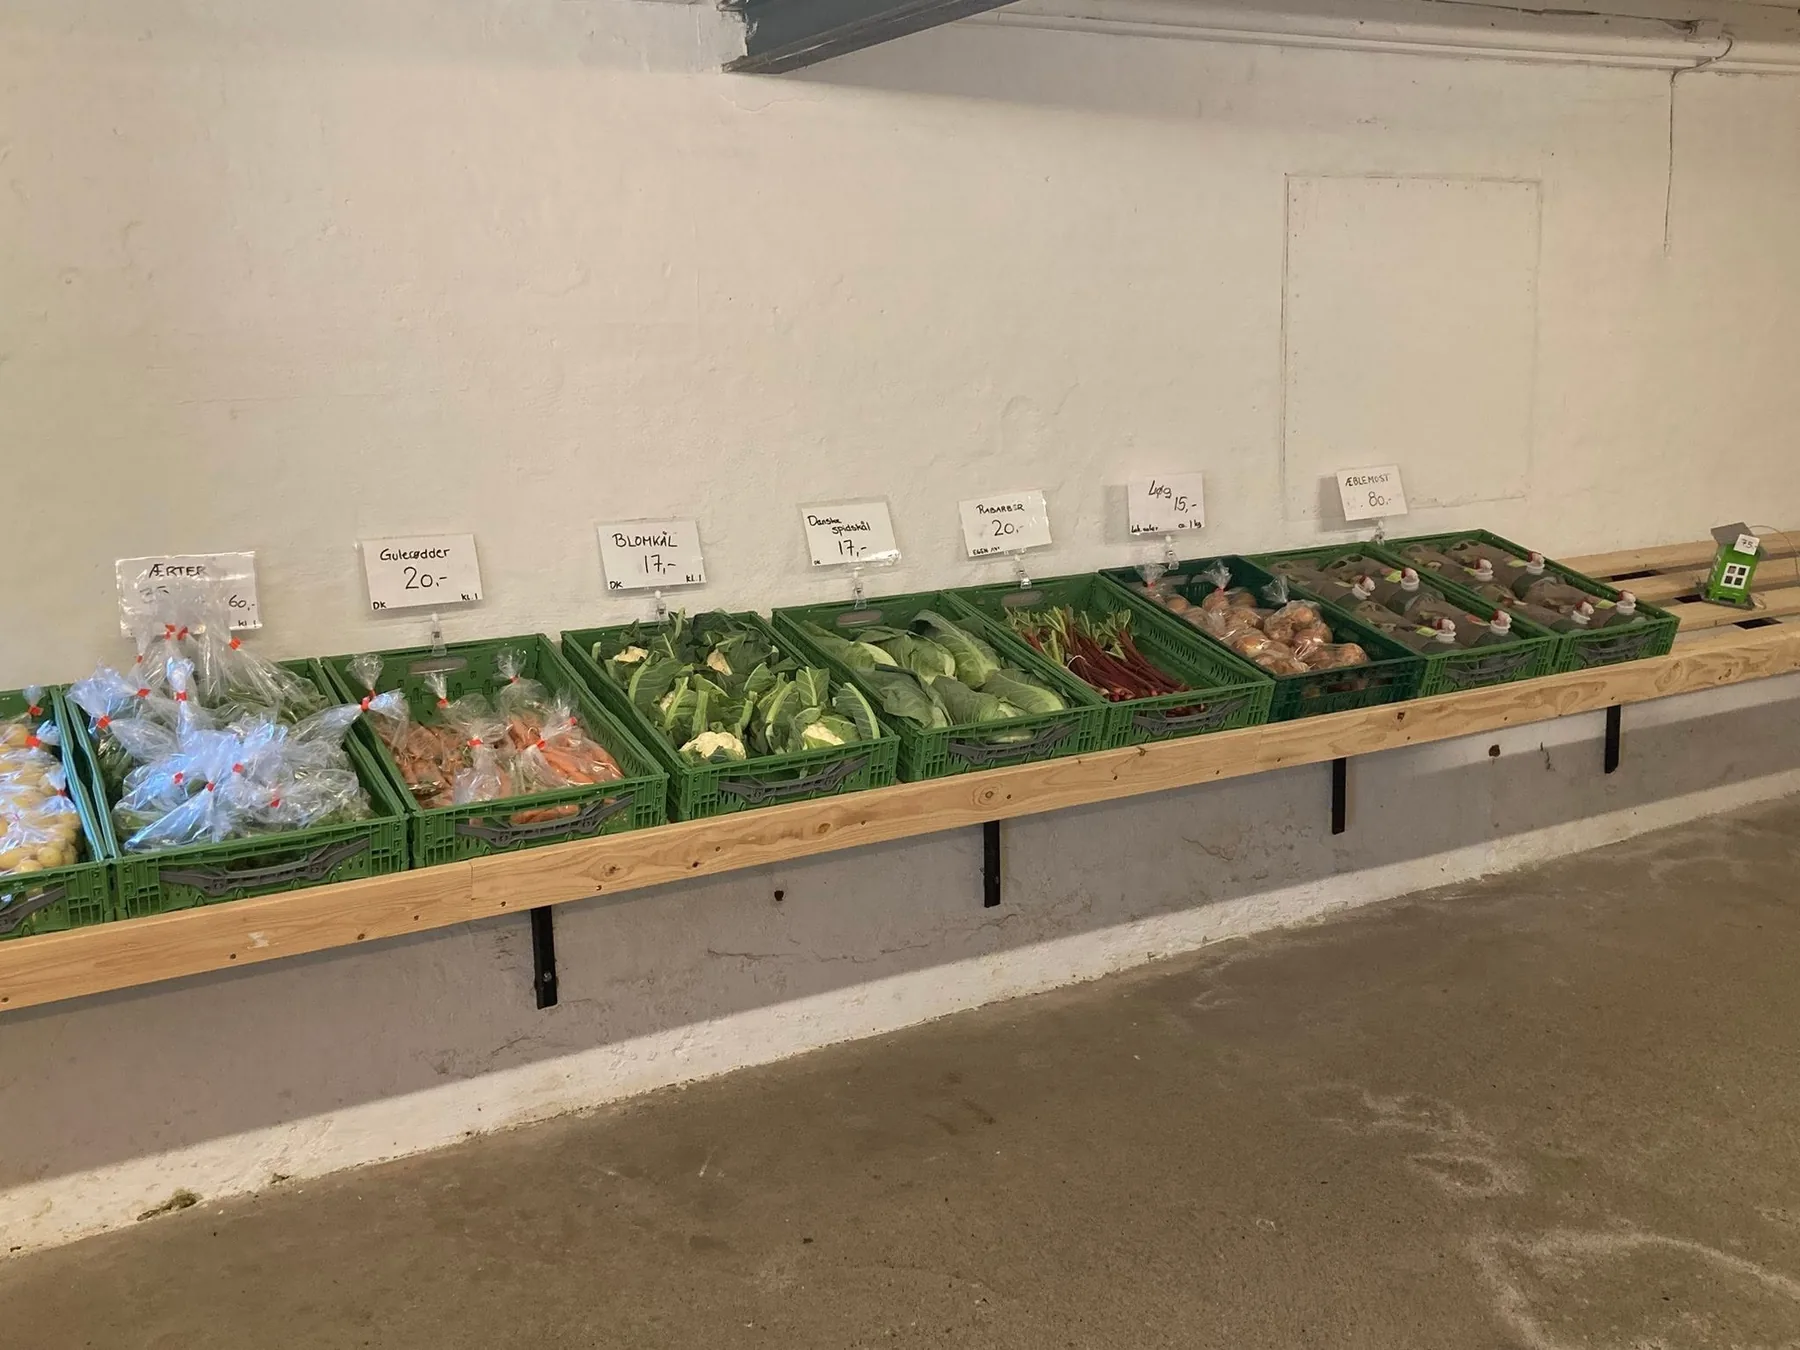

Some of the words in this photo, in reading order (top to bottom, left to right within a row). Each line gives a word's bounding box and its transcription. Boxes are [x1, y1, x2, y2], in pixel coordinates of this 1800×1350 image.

[1345, 472, 1390, 486] ÆBLEMOST
[976, 504, 1025, 514] RABARBER
[832, 521, 871, 536] spidskål
[992, 520, 1024, 536] 20,-
[612, 531, 678, 548] BLOMKÅL
[838, 540, 867, 558] 17,-
[149, 564, 207, 578] ÆRTER
[644, 554, 676, 575] 17,-
[404, 566, 448, 590] 20,-
[610, 581, 623, 590] DK
[228, 594, 256, 611] 60,-
[372, 602, 386, 610] DK
